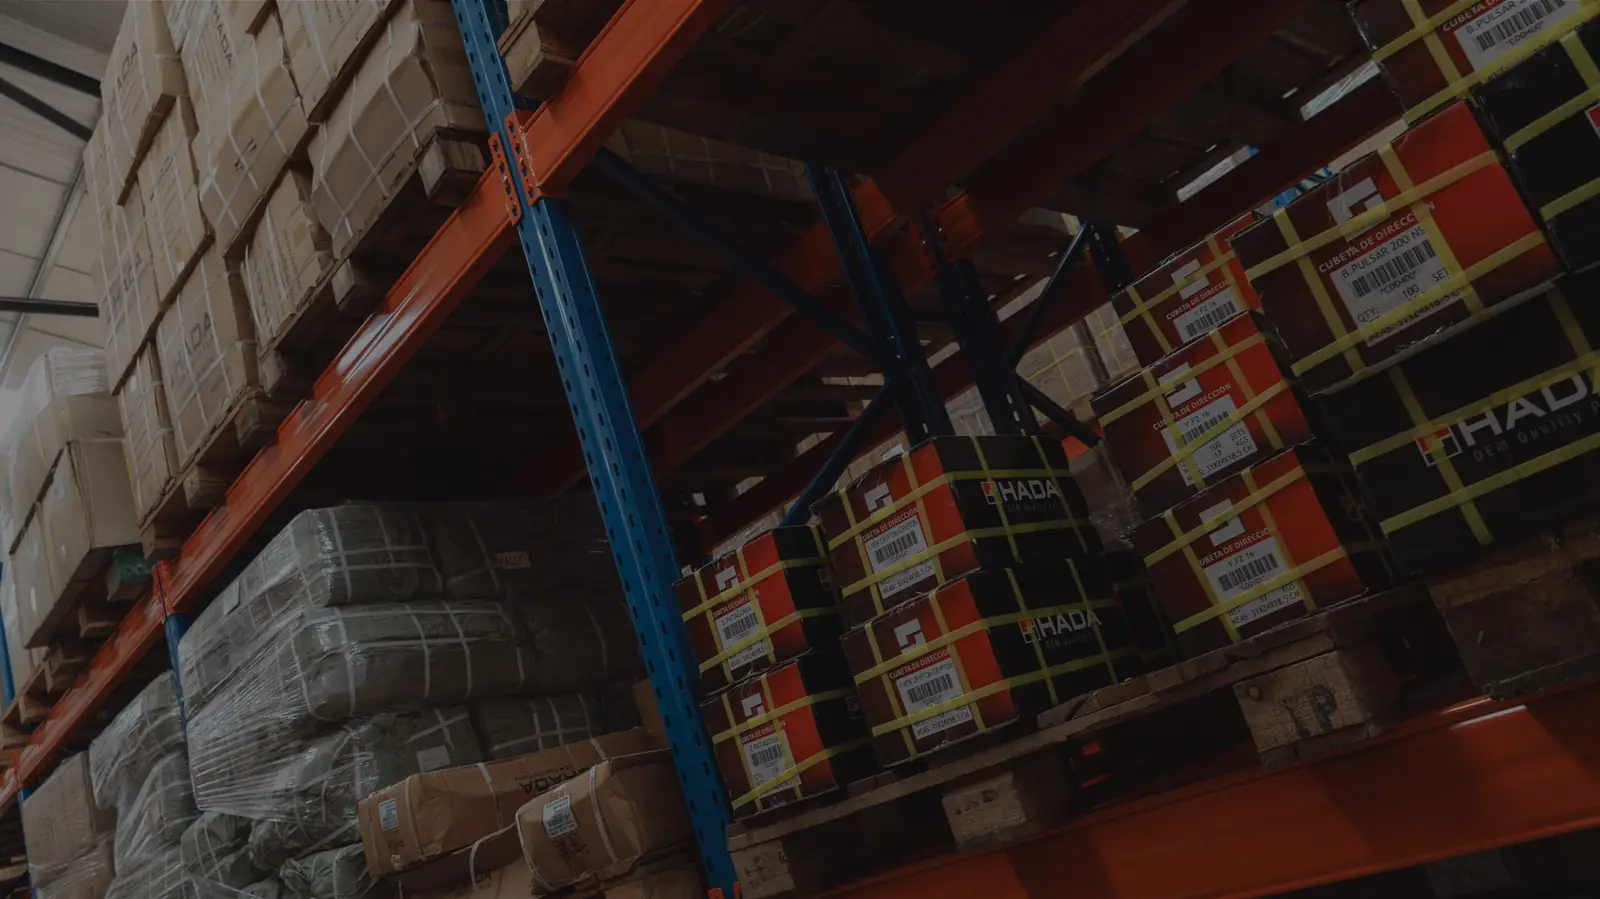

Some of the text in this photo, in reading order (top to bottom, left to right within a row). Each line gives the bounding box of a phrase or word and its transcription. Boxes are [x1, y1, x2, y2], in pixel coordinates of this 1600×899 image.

[1442, 3, 1486, 31] CUBETA
[1318, 200, 1436, 273] CUBETA DE DIRECCN
[1341, 246, 1390, 279] B.PULSAR
[1390, 235, 1409, 254] 200
[1401, 284, 1420, 299] 100
[1431, 269, 1451, 283] SET
[1165, 303, 1190, 320] CUBETA
[1190, 297, 1200, 307] DE
[1152, 412, 1181, 431] CUTA
[1181, 404, 1192, 415] DE
[1457, 372, 1600, 447] HAD
[1210, 428, 1246, 451] 100 SETS
[1473, 439, 1509, 462] OEM
[1516, 410, 1583, 444] Quality
[998, 478, 1062, 502] HADA
[862, 527, 881, 542] UBETA
[1200, 527, 1271, 566] UBETA DE DIRECCIO
[1036, 609, 1102, 638] HADA
[889, 665, 912, 680] CUBETA
[920, 649, 948, 667] DIRECCIO
